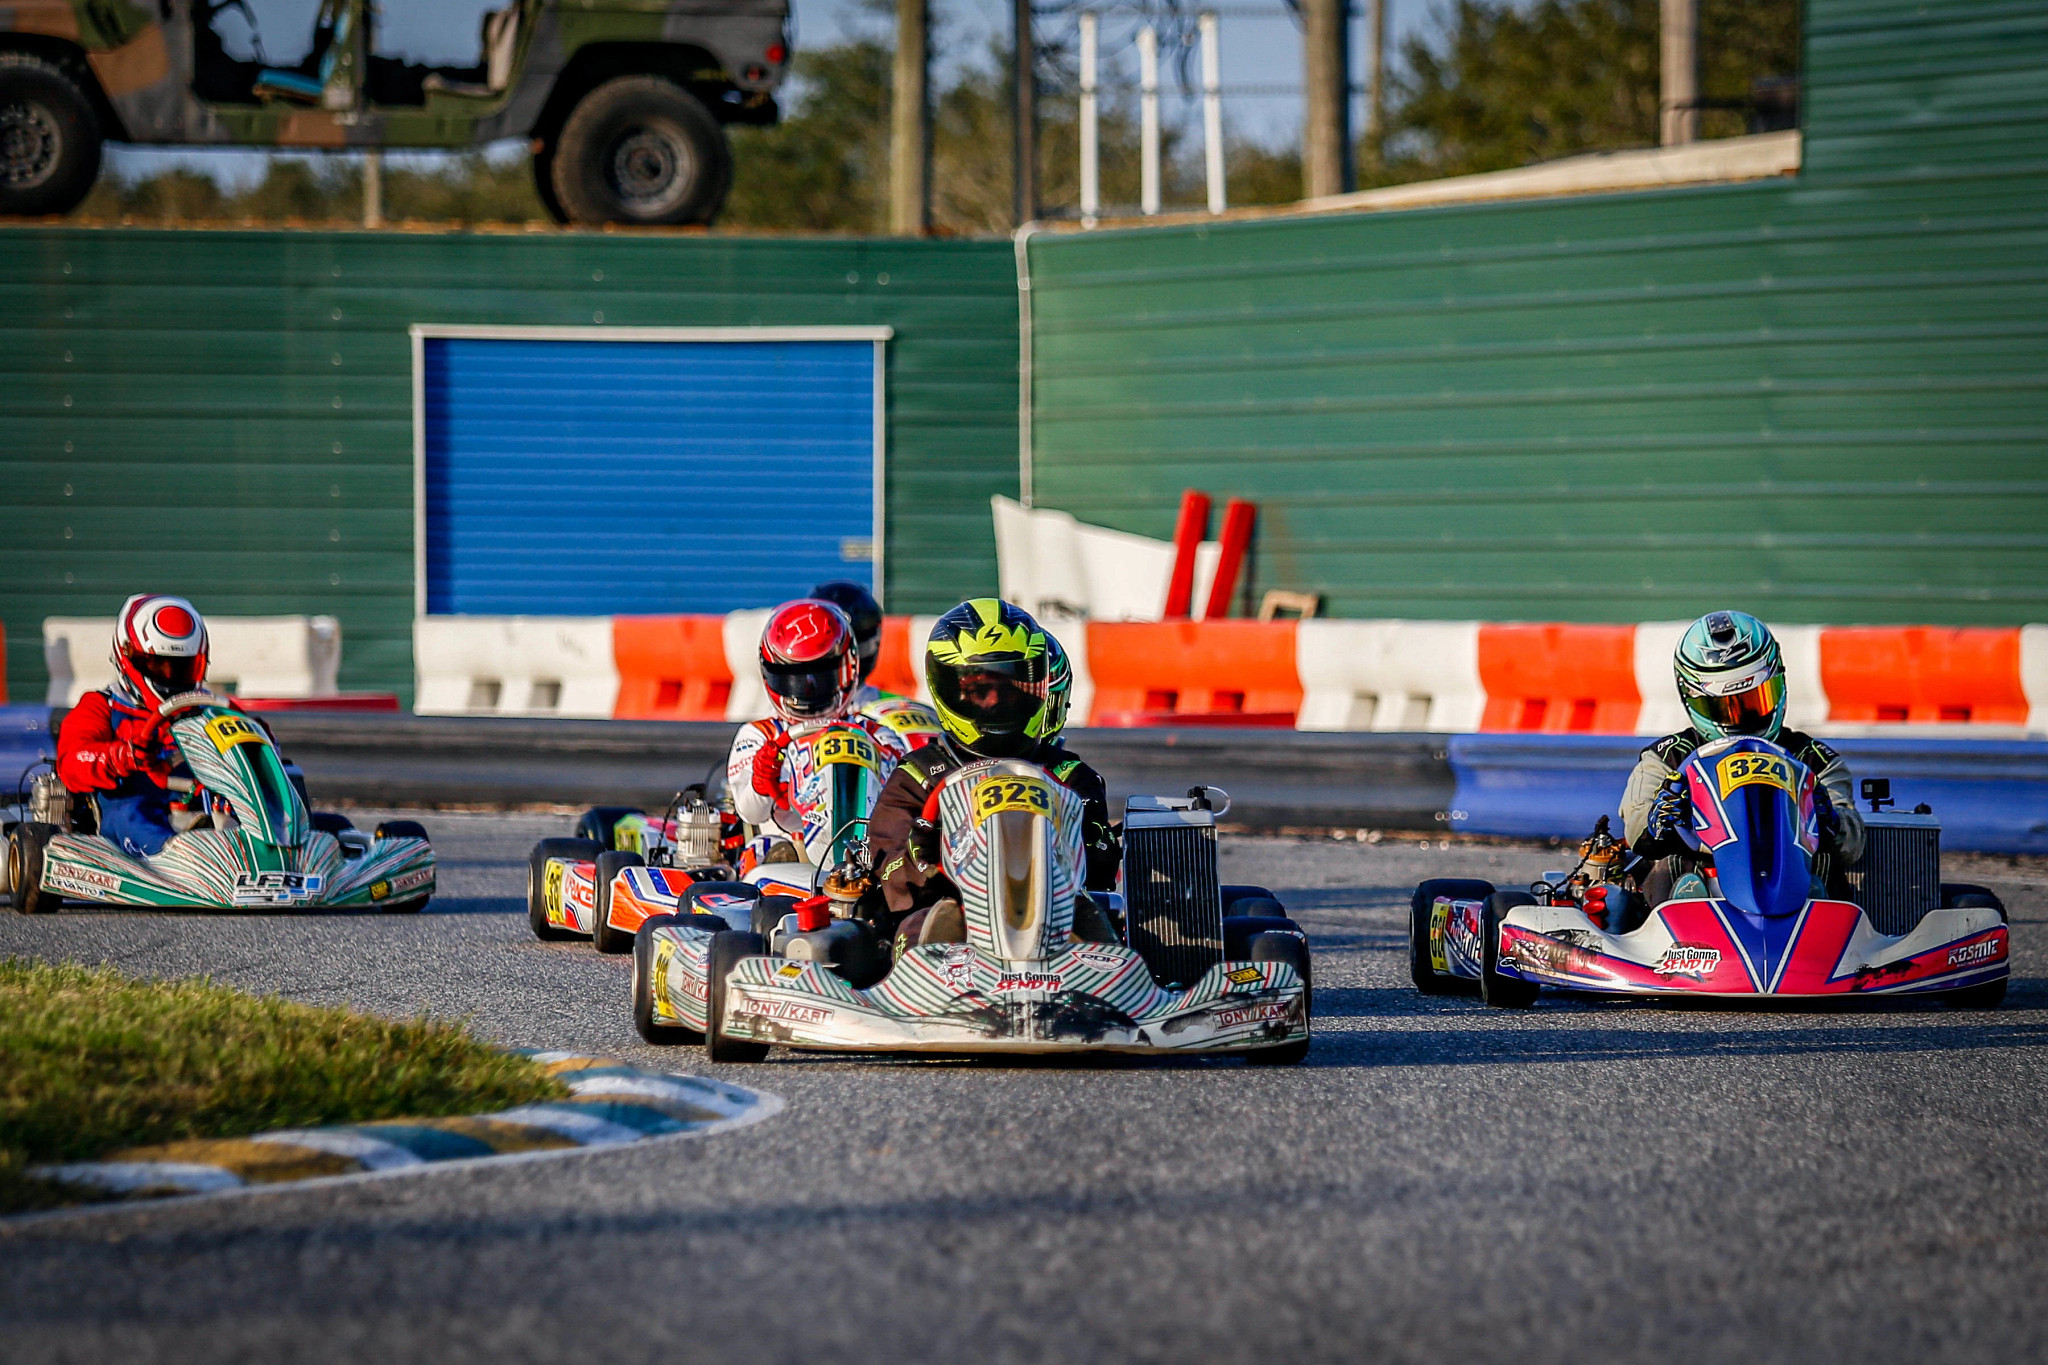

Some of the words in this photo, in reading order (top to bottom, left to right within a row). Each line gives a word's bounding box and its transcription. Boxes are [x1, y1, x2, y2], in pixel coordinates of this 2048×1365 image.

[824, 738, 872, 762] 315
[1729, 758, 1788, 781] 324
[982, 783, 1050, 810] 323
[1667, 949, 1685, 960] Just
[1687, 949, 1718, 960] Gonna
[1657, 959, 1701, 972] SEND
[1703, 959, 1715, 970] IT
[1000, 972, 1023, 982] Just
[1024, 971, 1061, 982] Gonna
[1230, 970, 1259, 981] OMP
[990, 980, 1045, 994] SEND
[1045, 980, 1063, 991] IT
[745, 1000, 781, 1016] TONY
[789, 1004, 830, 1023] KART
[1218, 1008, 1250, 1025] TONY
